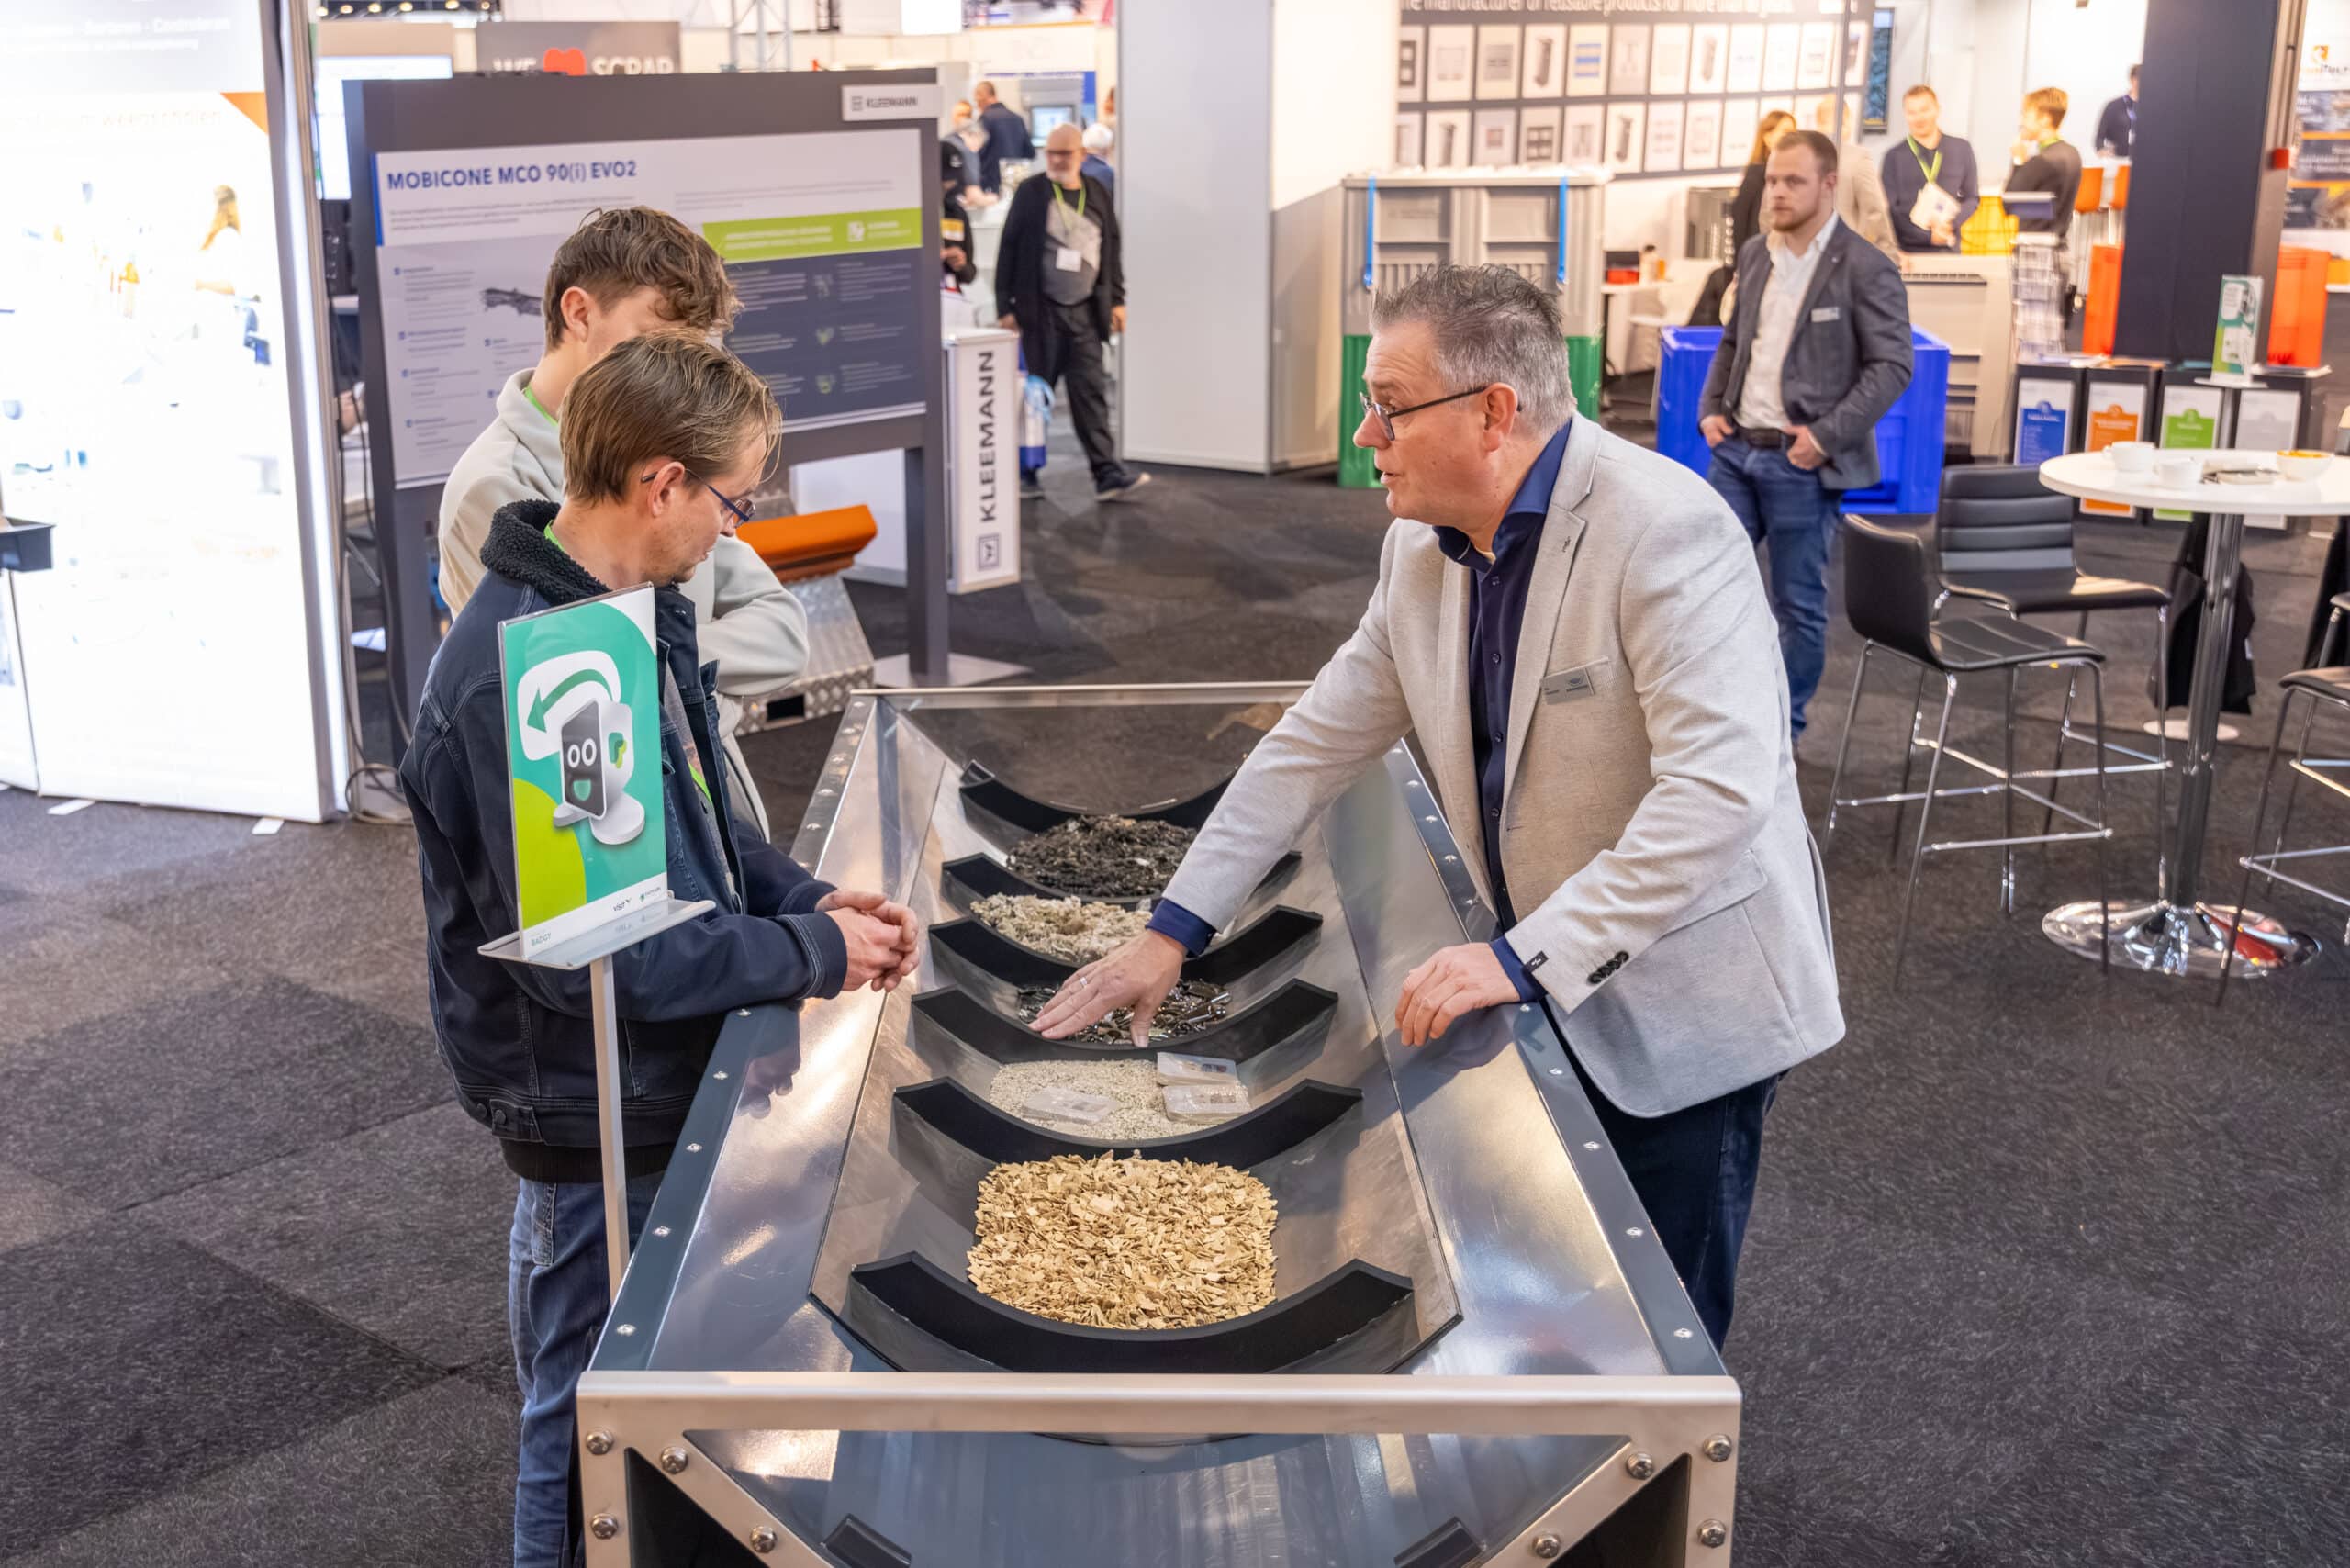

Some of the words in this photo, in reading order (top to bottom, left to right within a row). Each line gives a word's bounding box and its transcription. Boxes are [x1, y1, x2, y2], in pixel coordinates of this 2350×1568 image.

[387, 167, 493, 190] MOBICONE
[498, 164, 541, 184] MCO
[546, 162, 587, 182] 90(i)
[591, 160, 637, 179] EVO2
[978, 350, 997, 522] KLEEMANN
